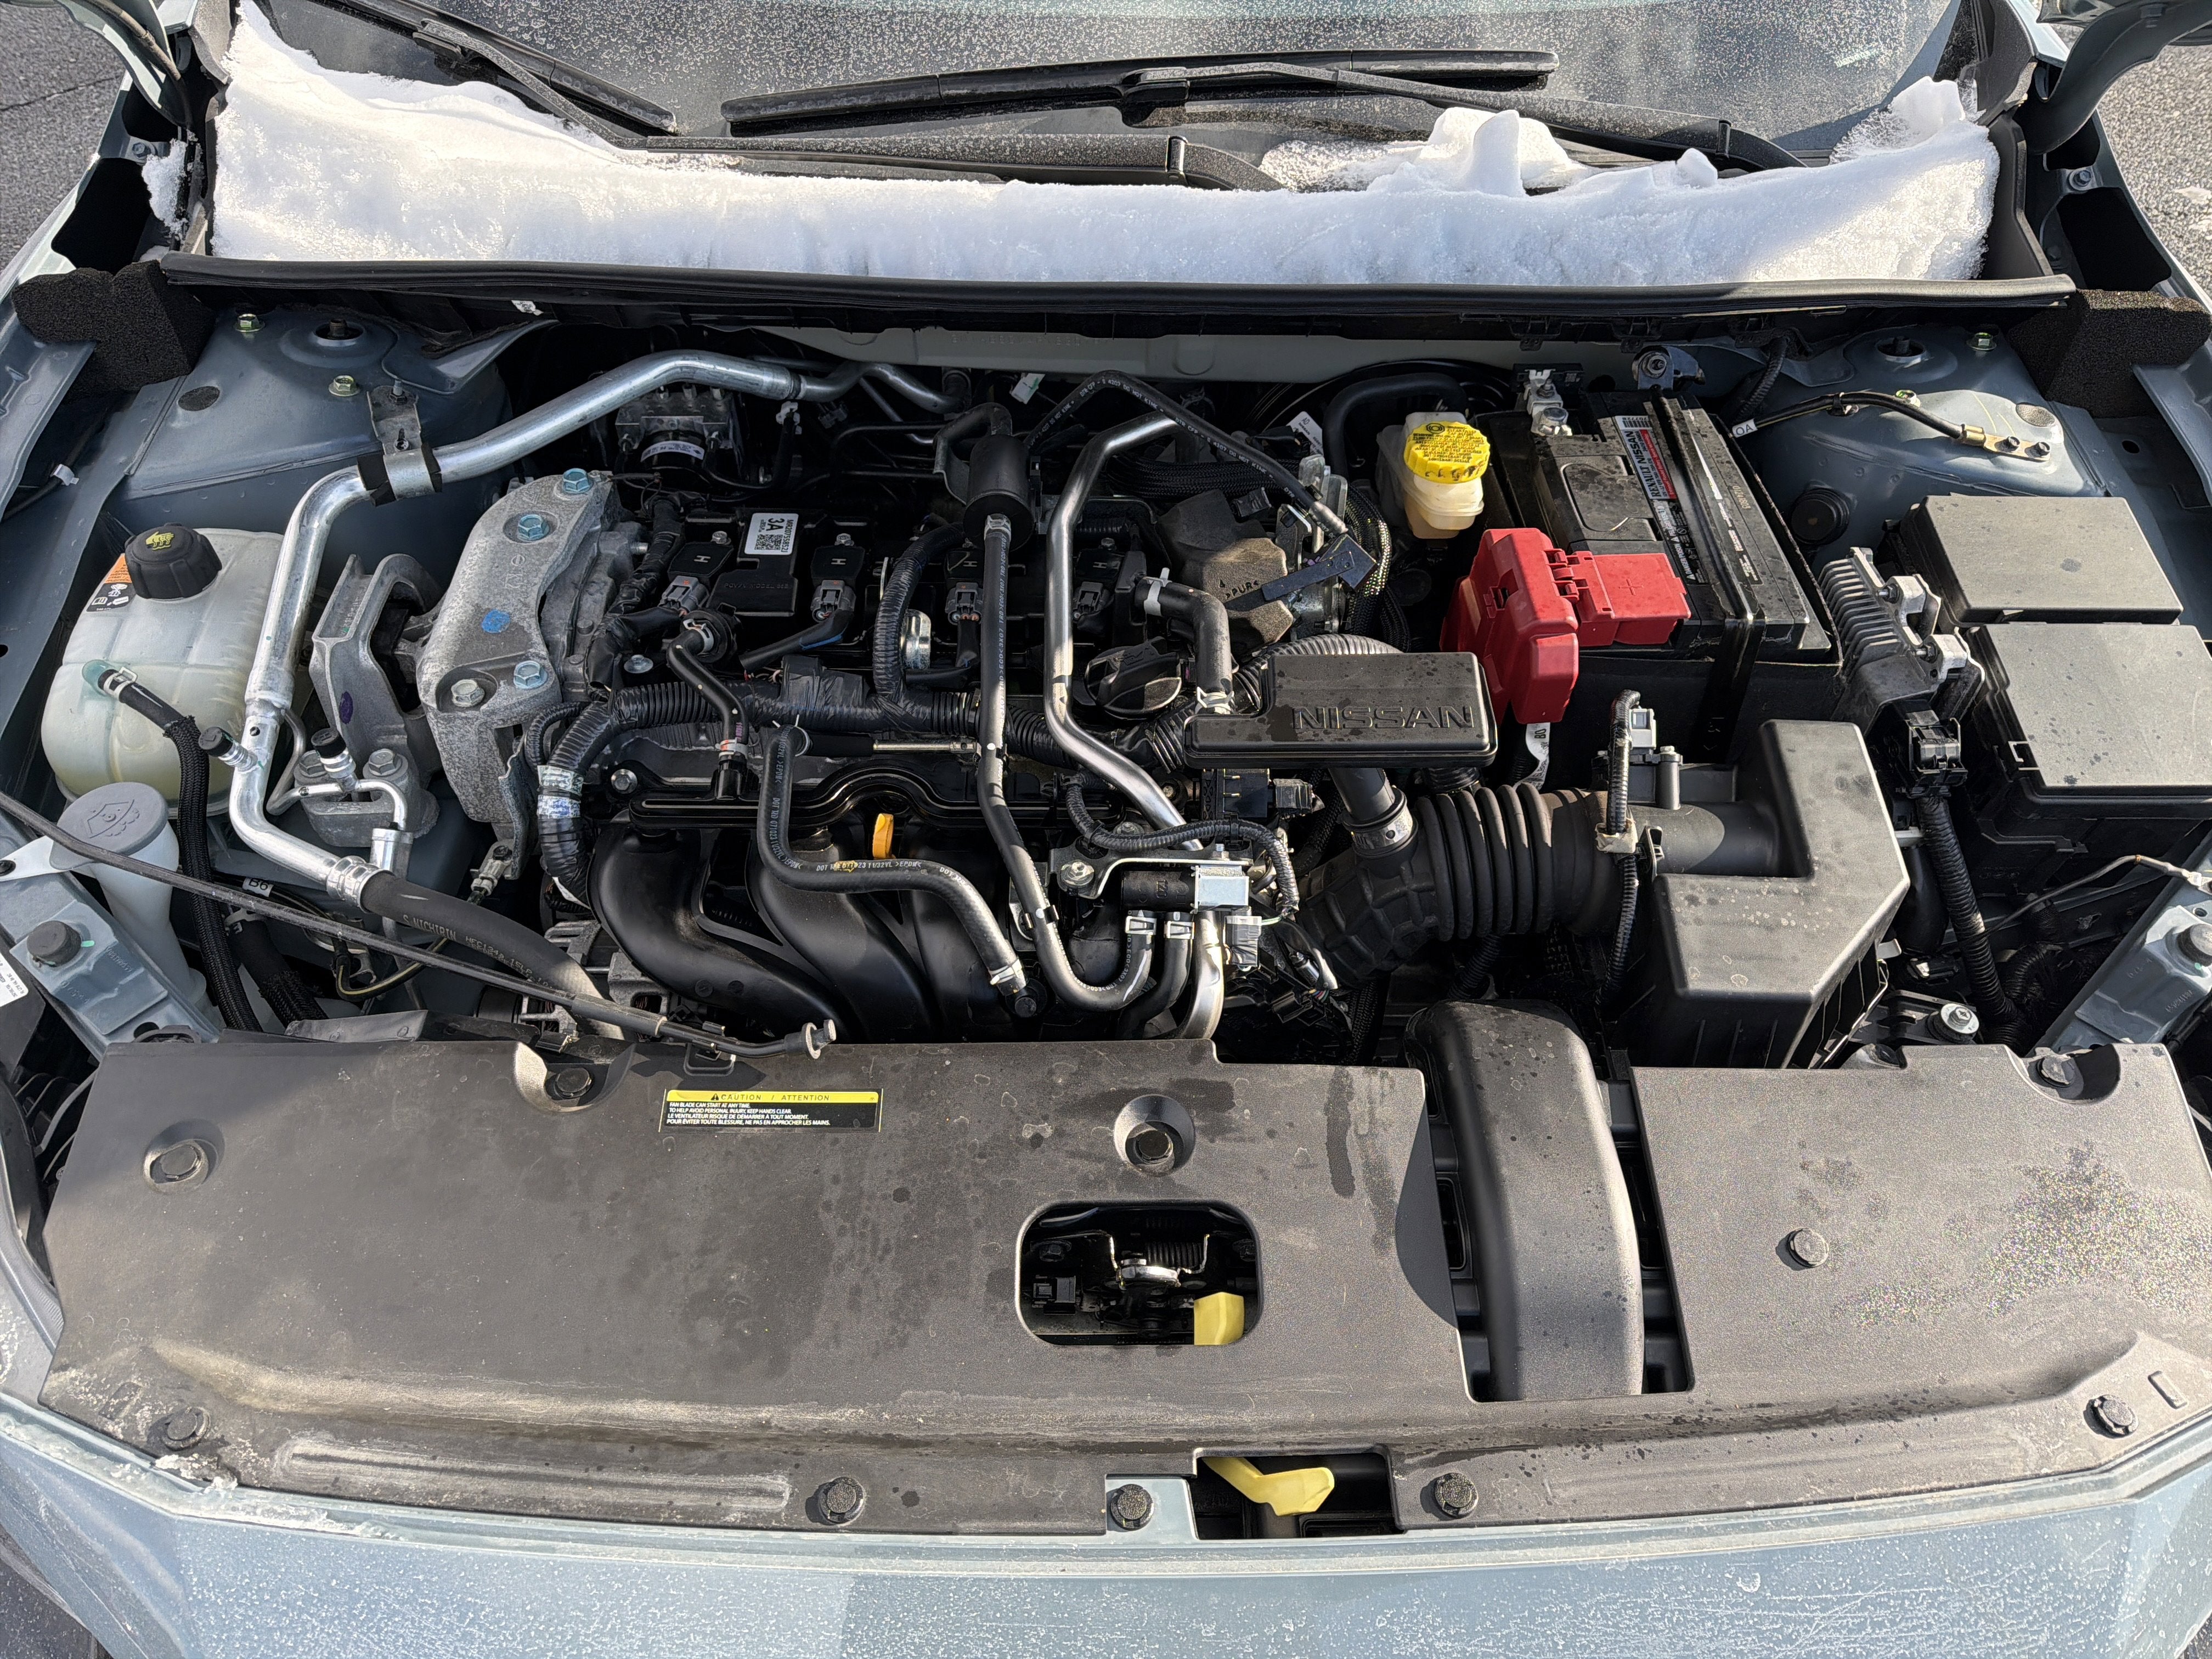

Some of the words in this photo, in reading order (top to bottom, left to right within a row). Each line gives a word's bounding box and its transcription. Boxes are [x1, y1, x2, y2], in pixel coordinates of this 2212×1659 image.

[1623, 431, 1646, 464] NISSAN
[1638, 465, 1661, 496] RENAULT
[766, 518, 785, 531] 3A
[1292, 706, 1474, 729] NISSAN
[249, 878, 268, 890] B6
